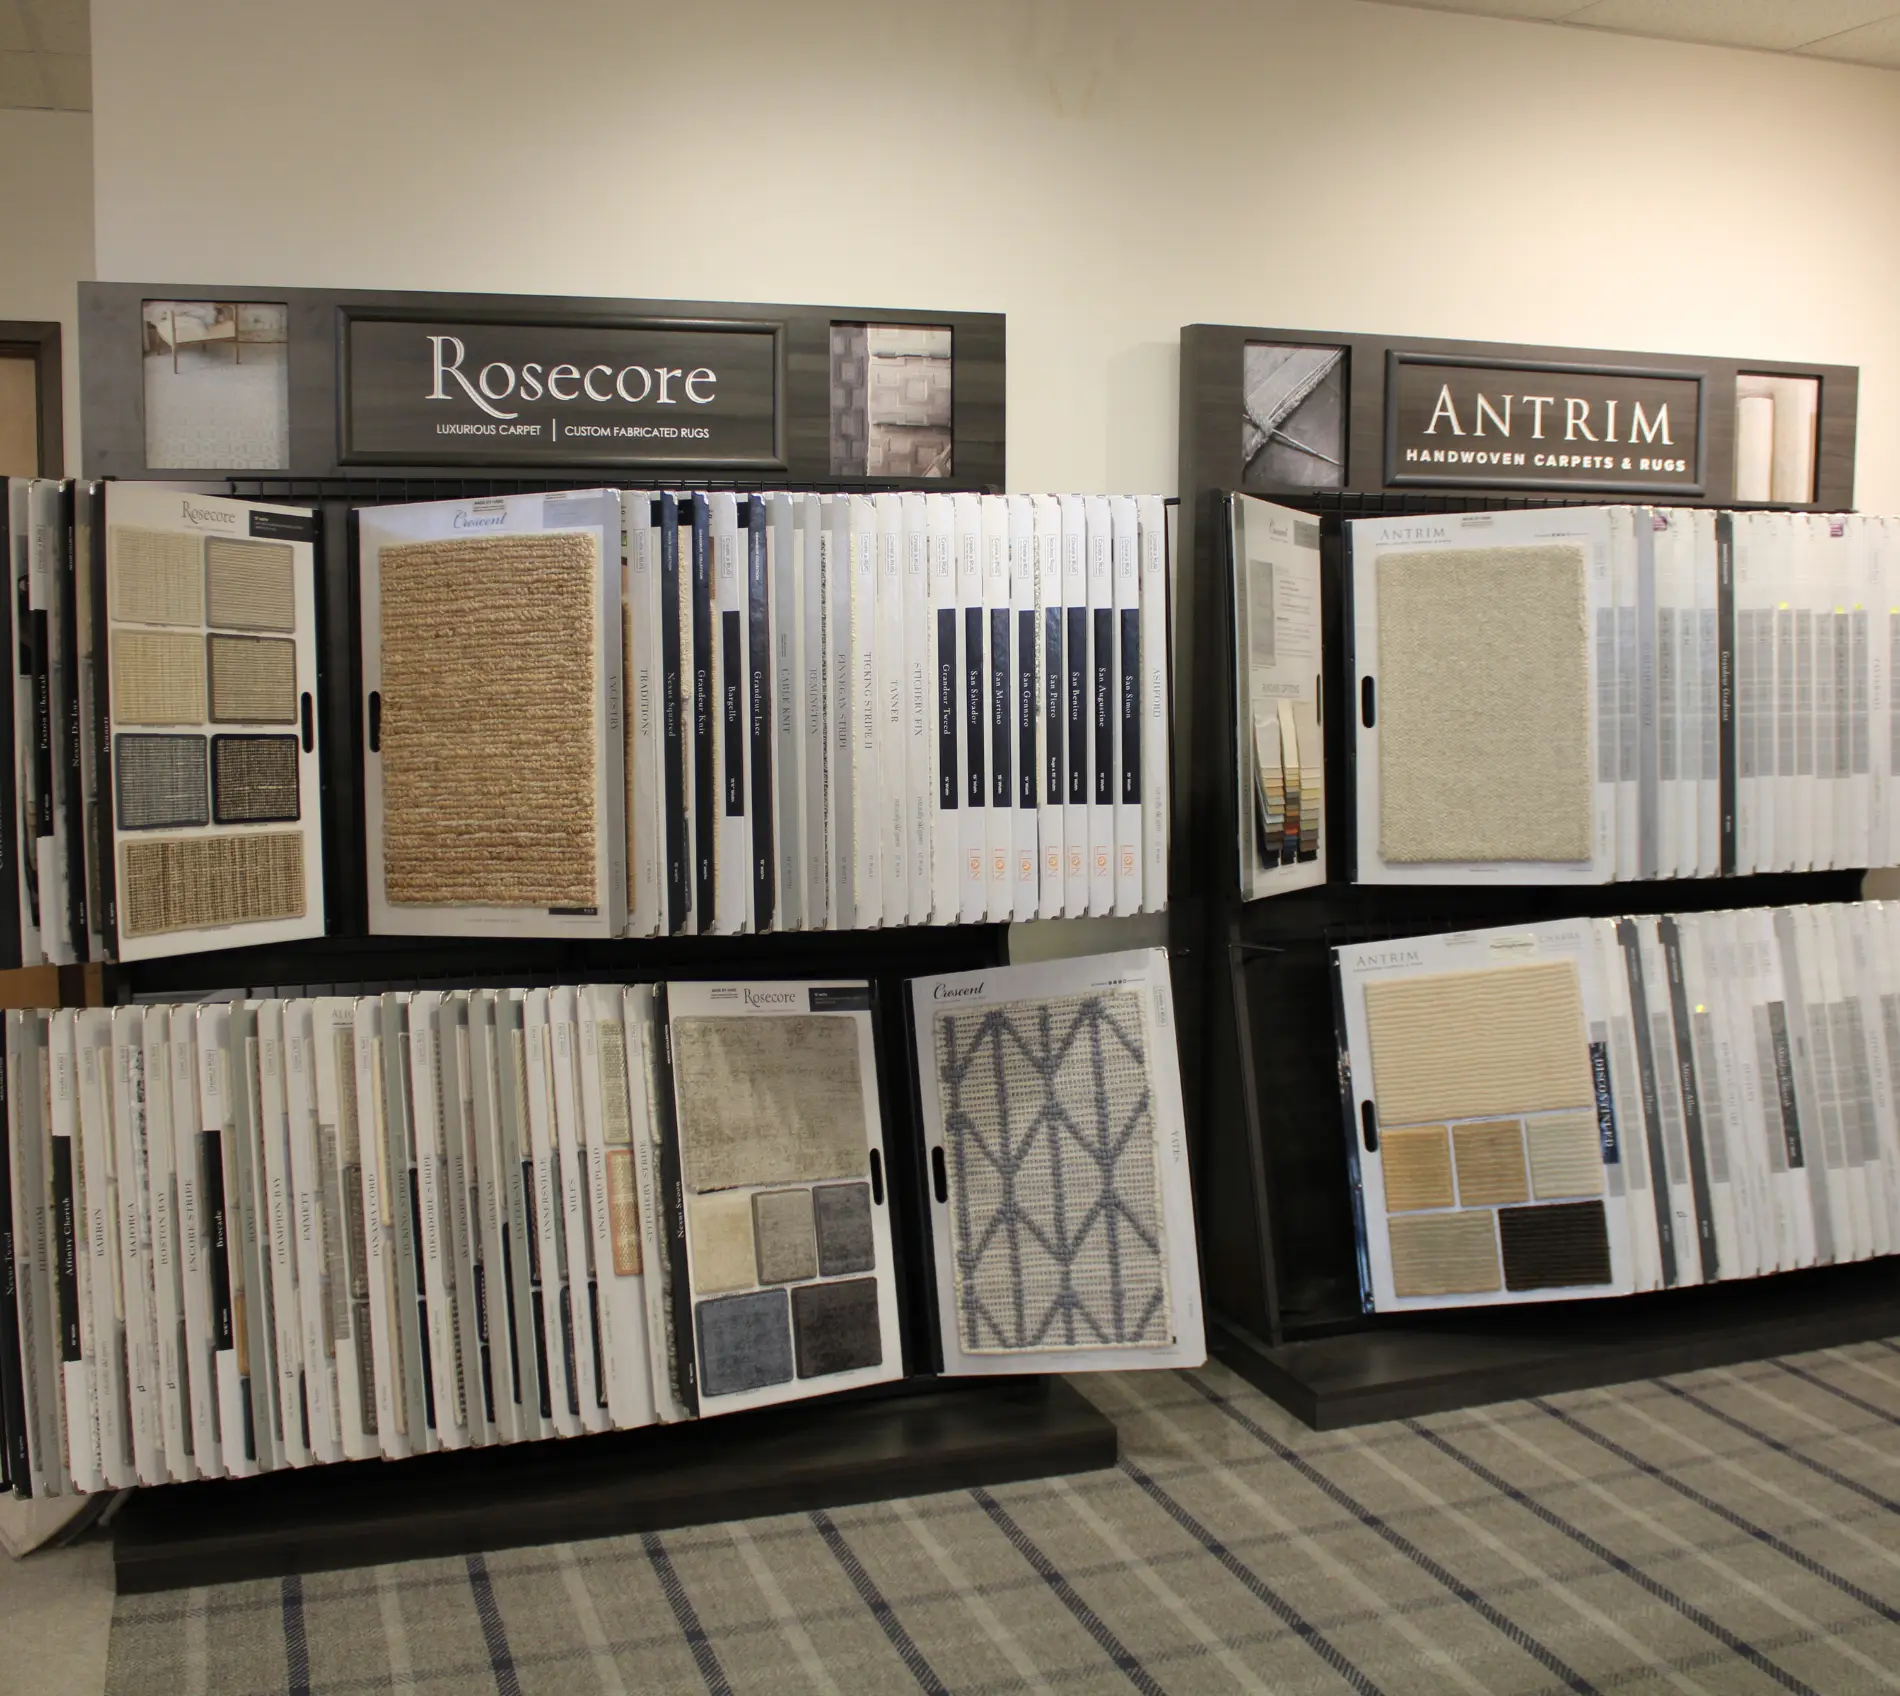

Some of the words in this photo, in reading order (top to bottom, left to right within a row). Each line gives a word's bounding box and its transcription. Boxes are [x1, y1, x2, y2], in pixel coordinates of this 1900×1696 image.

[425, 336, 717, 420] Rosecore
[437, 424, 496, 436] LUXURIOUS
[499, 425, 541, 436] CARPET
[1423, 384, 1674, 445] ANTRIM
[565, 426, 611, 437] CUSTOM
[613, 427, 678, 438] FABRICATED
[681, 428, 709, 439] RUGS
[1406, 449, 1525, 465] HANDWOVEN
[1534, 454, 1613, 469] CARPETS
[1621, 458, 1632, 470] &
[1640, 459, 1686, 472] RUGS
[181, 501, 236, 524] Rosecore
[453, 510, 507, 529] Crescent
[1380, 526, 1446, 541] ANTRIM
[667, 672, 676, 699] Nexus
[697, 669, 706, 712] Grandeur
[863, 652, 873, 697] TICKING
[913, 662, 923, 715] STICHERY
[942, 664, 951, 705] Grandeur
[970, 670, 979, 686] San
[995, 672, 1004, 687] San
[1022, 672, 1031, 688] San
[1049, 674, 1058, 690] San
[1071, 671, 1080, 687] San
[1098, 667, 1106, 683] San
[1125, 675, 1133, 691] San
[640, 668, 650, 736] TRADITIONS
[727, 686, 737, 722] Bargello
[754, 671, 763, 713] Grandeur
[890, 679, 900, 723] TANNER
[969, 689, 980, 725] Salvador
[994, 690, 1005, 725] Martino
[1048, 692, 1059, 718] Pietro
[1070, 689, 1081, 721] Benitos
[1097, 685, 1107, 727] Augustine
[1124, 693, 1134, 719] Simon
[1151, 667, 1161, 718] ASHFORD
[666, 702, 677, 737] Squared
[698, 715, 707, 735] Knit
[754, 715, 763, 736] Lace
[782, 707, 792, 734] KNIT
[863, 700, 873, 739] STRIPE
[943, 708, 952, 735] Tweed
[1021, 691, 1032, 727] Gennaro
[913, 719, 924, 736] FIX
[1357, 951, 1420, 967] ANTRIM
[744, 989, 796, 1008] Rosecore
[934, 982, 985, 1000] Crescent
[1594, 1058, 1616, 1147] DISCONTINUED
[1170, 1130, 1181, 1164] YATES
[156, 1191, 165, 1213] BAY
[367, 1173, 377, 1207] CORD
[94, 1208, 104, 1257] BARRON
[158, 1216, 168, 1265] BOSTON
[214, 1210, 224, 1248] Brocade
[370, 1209, 380, 1257] PANAMA
[64, 1238, 75, 1276] Affinity
[187, 1225, 198, 1272] ENCORE
